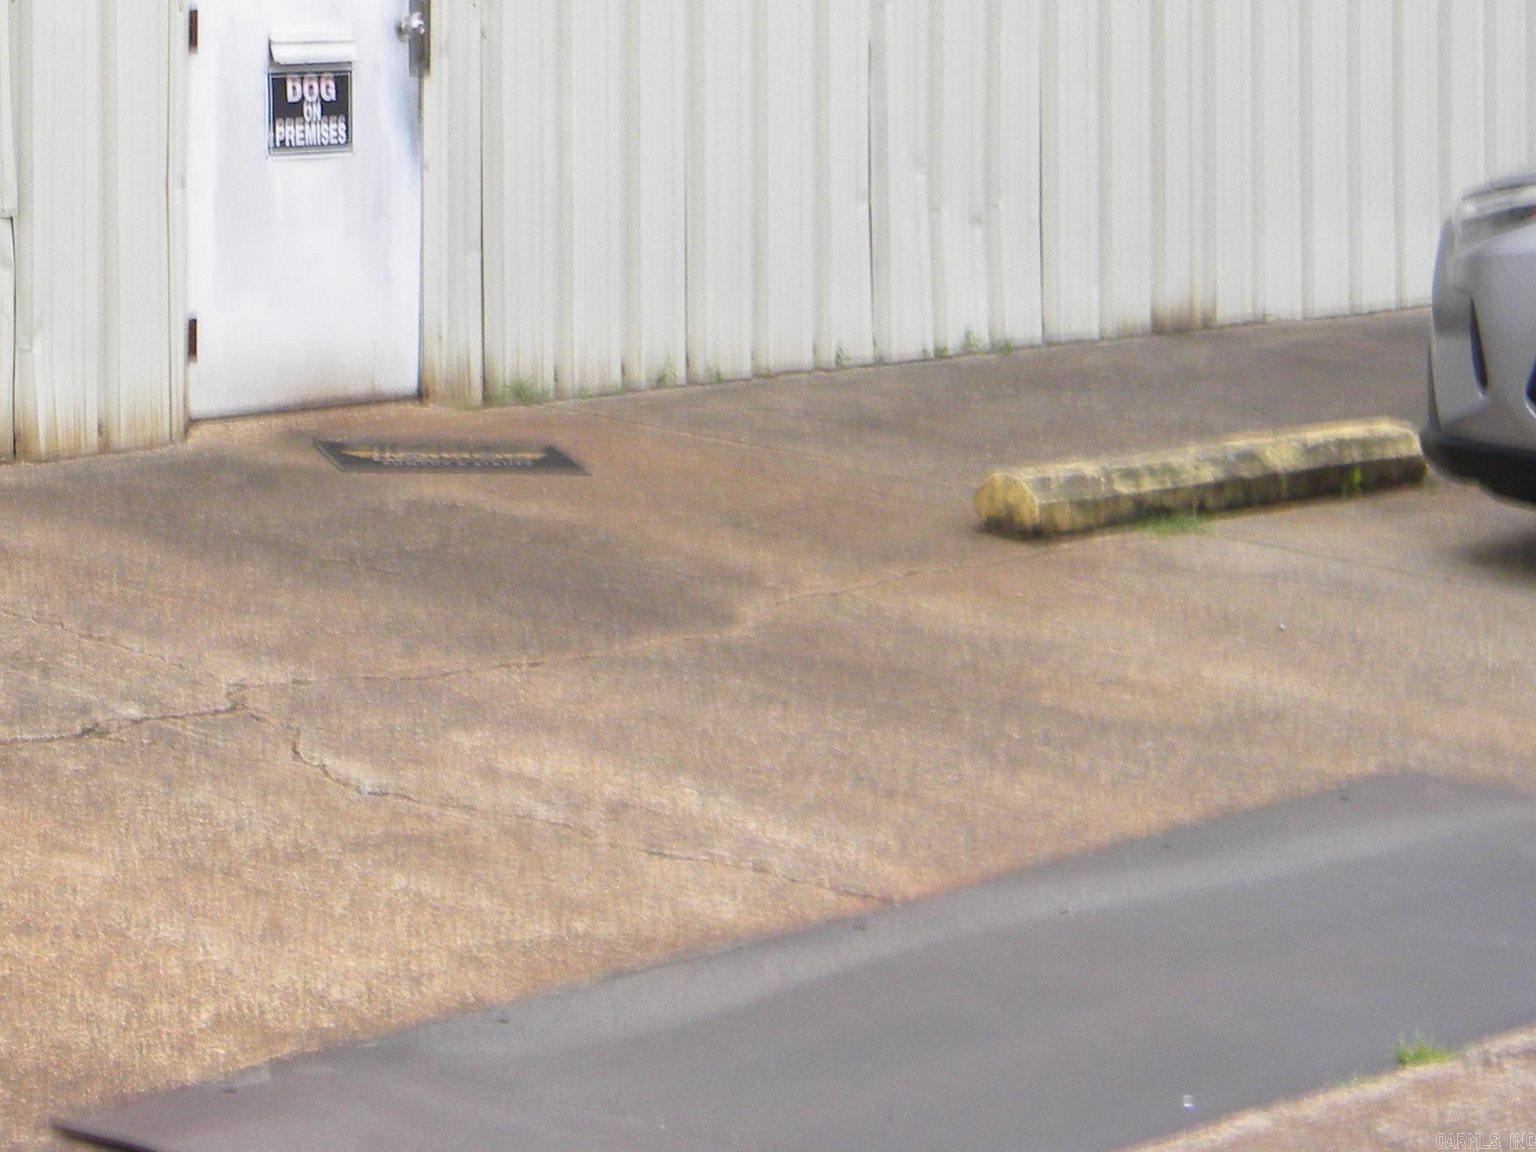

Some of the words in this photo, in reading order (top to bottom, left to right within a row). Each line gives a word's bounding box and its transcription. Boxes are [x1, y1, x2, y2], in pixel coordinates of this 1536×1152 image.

[286, 74, 337, 103] DOG
[303, 100, 322, 123] ON
[275, 115, 347, 148] PREMISES
